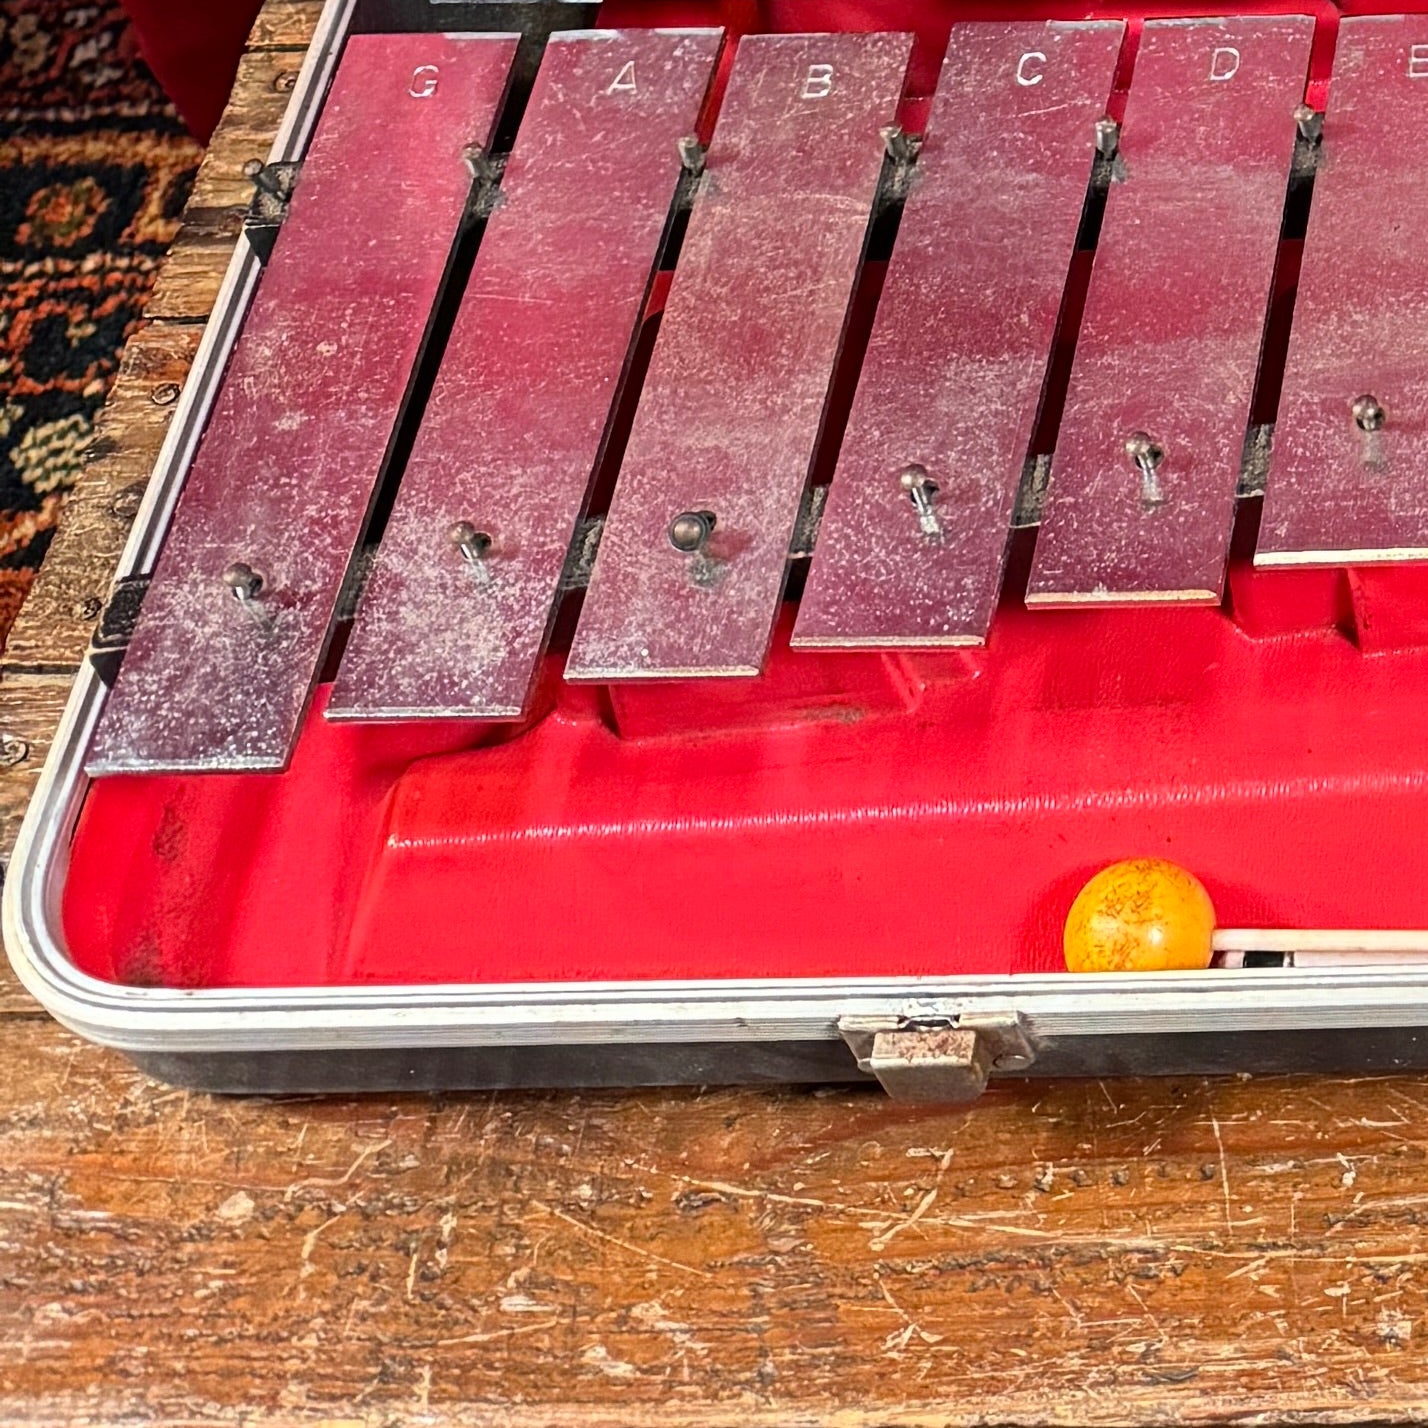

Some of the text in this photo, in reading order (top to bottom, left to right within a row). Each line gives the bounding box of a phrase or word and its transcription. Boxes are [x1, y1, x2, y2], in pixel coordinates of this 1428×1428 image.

[409, 65, 440, 99] G
[607, 60, 637, 96] A
[801, 63, 834, 99] B
[1016, 51, 1047, 87] C
[1210, 47, 1240, 81] D
